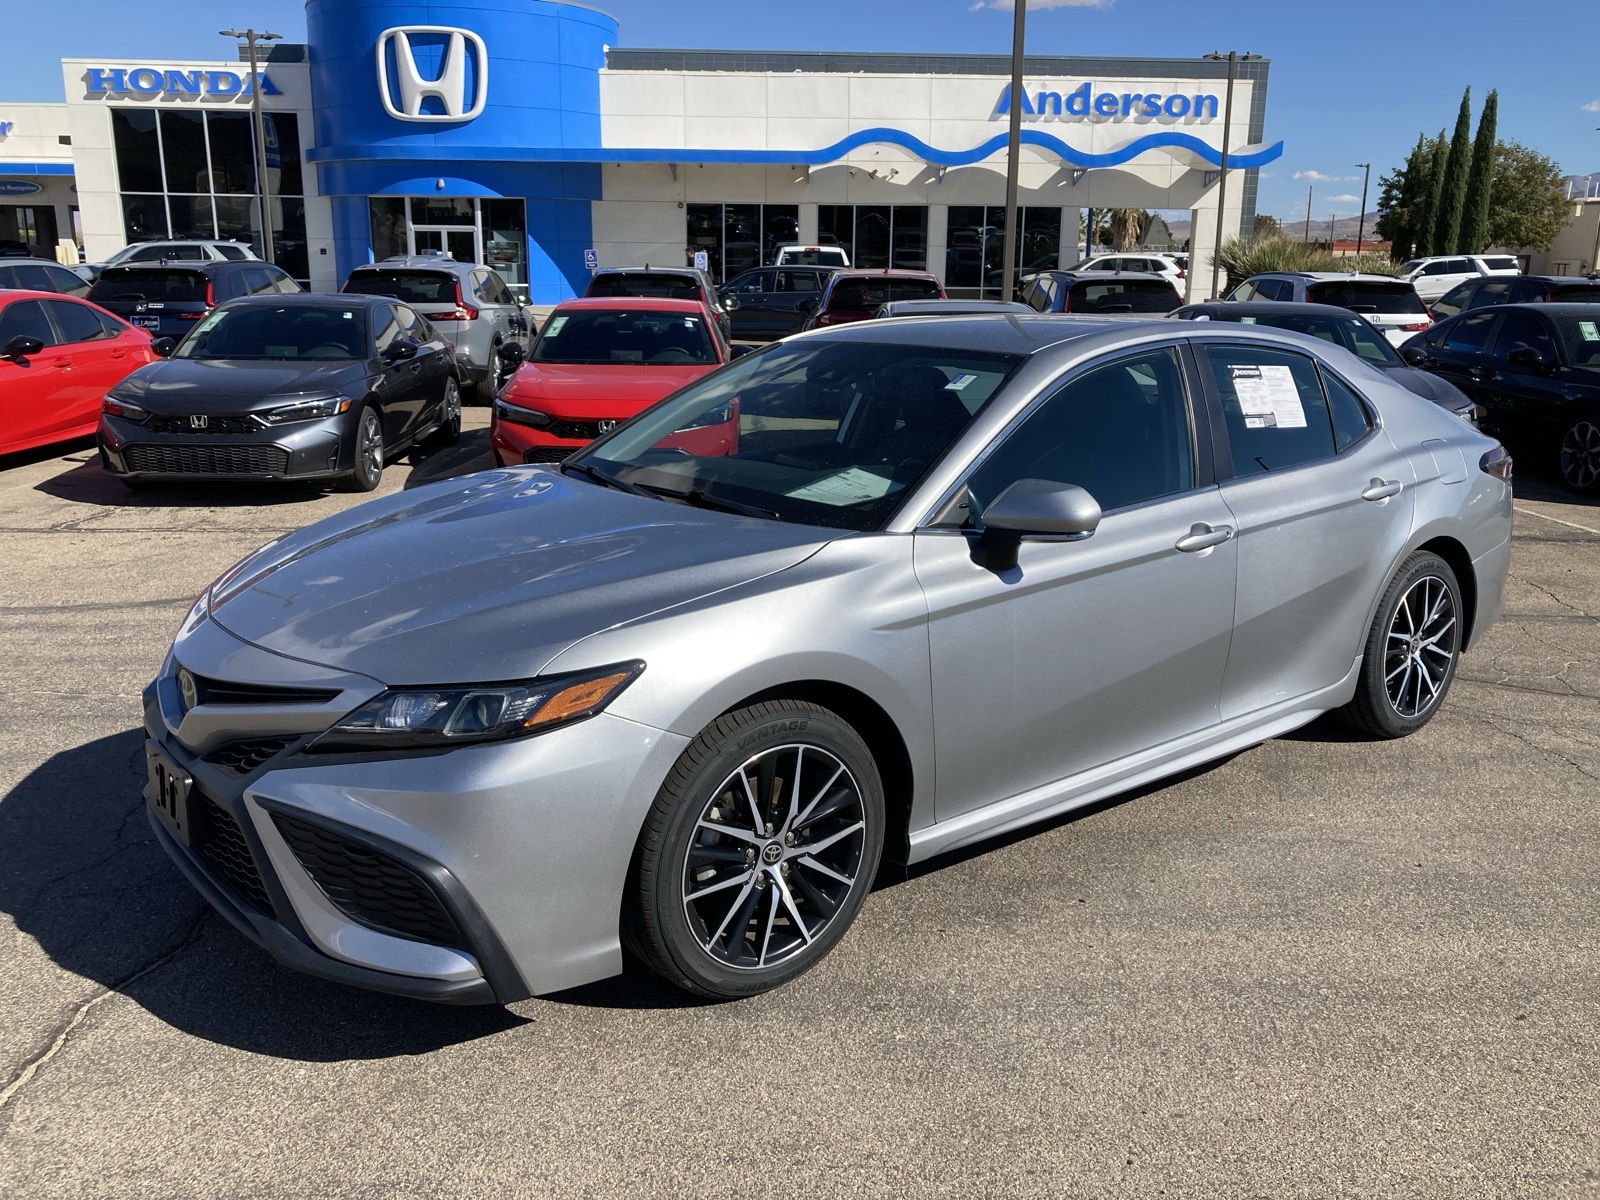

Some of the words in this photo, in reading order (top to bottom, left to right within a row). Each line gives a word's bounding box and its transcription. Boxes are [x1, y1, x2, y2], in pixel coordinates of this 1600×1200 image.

[86, 67, 284, 96] HONDA
[997, 81, 1219, 118] Anderson
[1406, 561, 1435, 581] VANTAGE
[736, 720, 809, 751] VANTAGE
